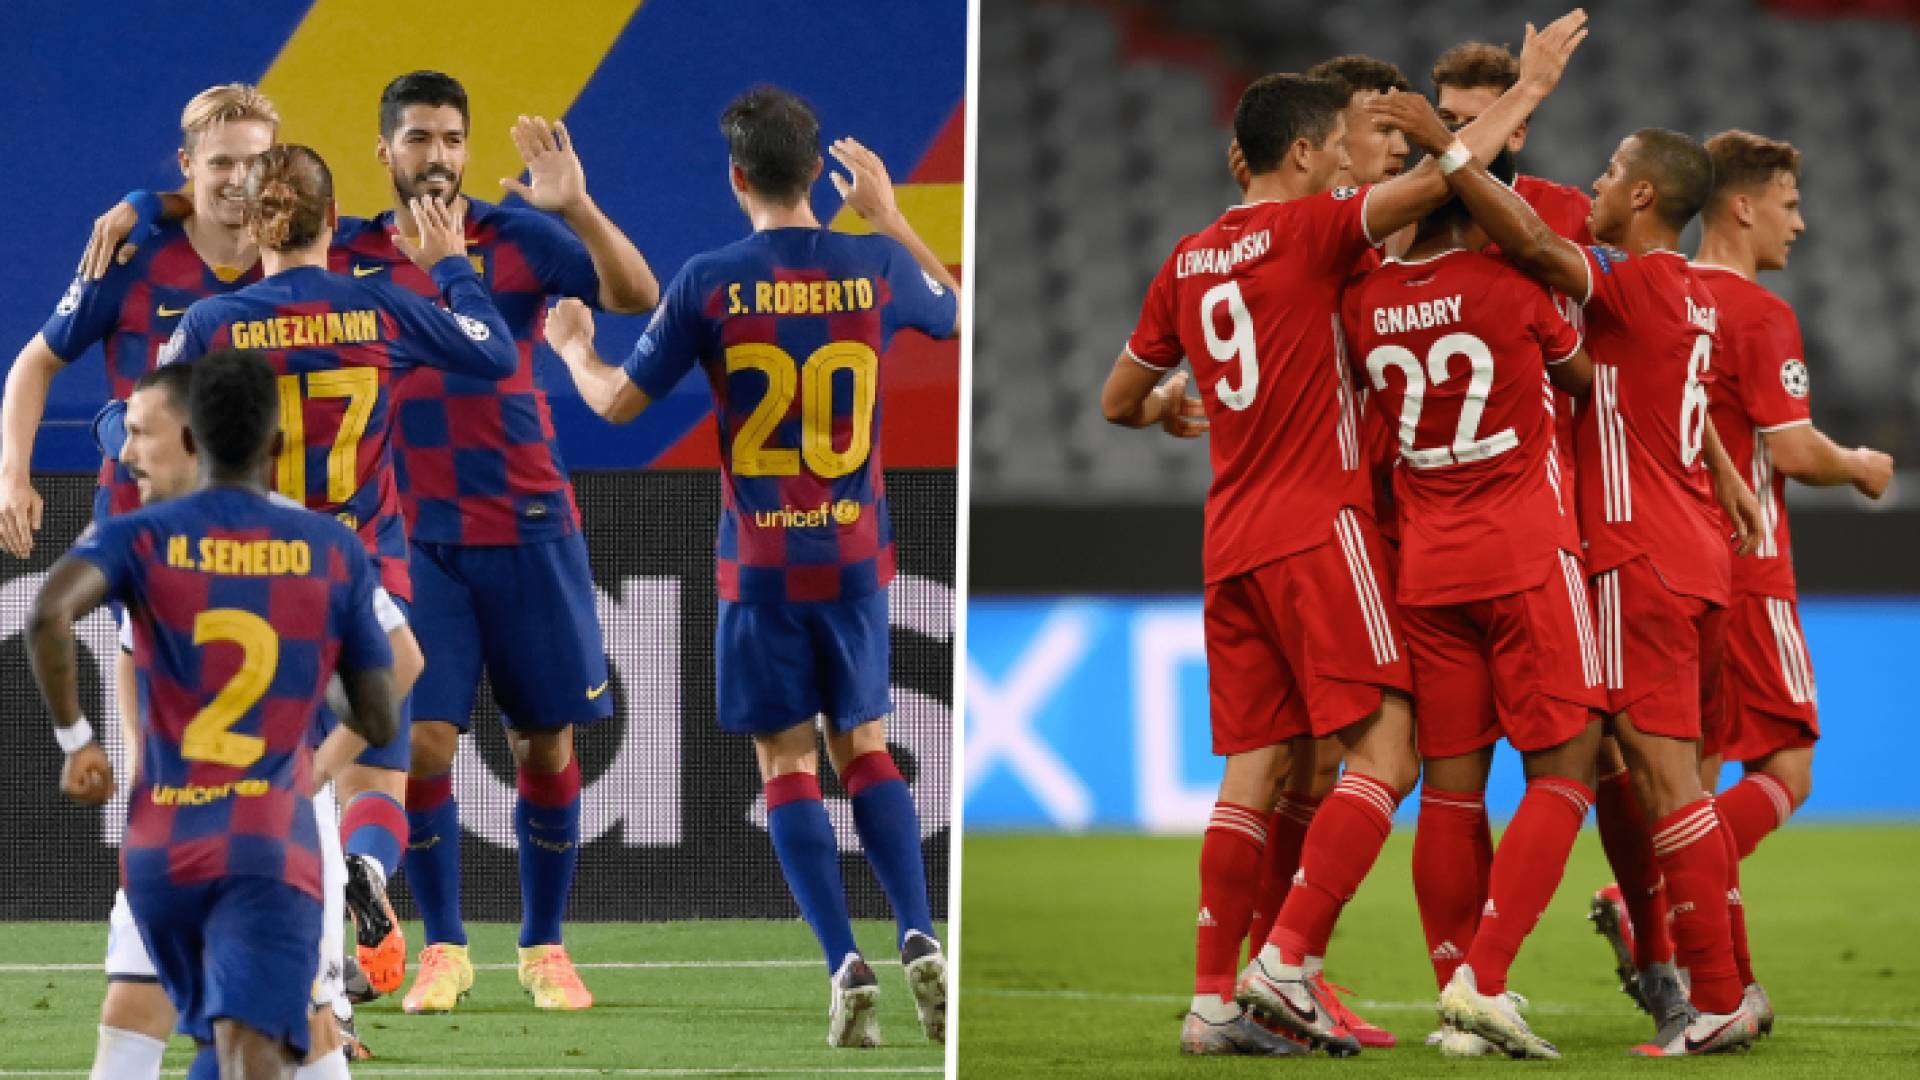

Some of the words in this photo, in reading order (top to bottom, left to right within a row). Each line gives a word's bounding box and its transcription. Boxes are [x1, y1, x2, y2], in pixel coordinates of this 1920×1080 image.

[232, 310, 378, 349] GRIEZMANN
[727, 283, 749, 315] S.
[755, 278, 873, 314] ROBERTO
[1201, 280, 1259, 411] 9
[1373, 294, 1462, 335] GNABRY
[276, 366, 378, 504] 17
[725, 340, 878, 478] 20
[1366, 332, 1519, 469] 22
[1680, 335, 1711, 468] 6
[198, 538, 311, 576] SEMEDO
[755, 502, 829, 528] unicef
[180, 608, 279, 768] 2
